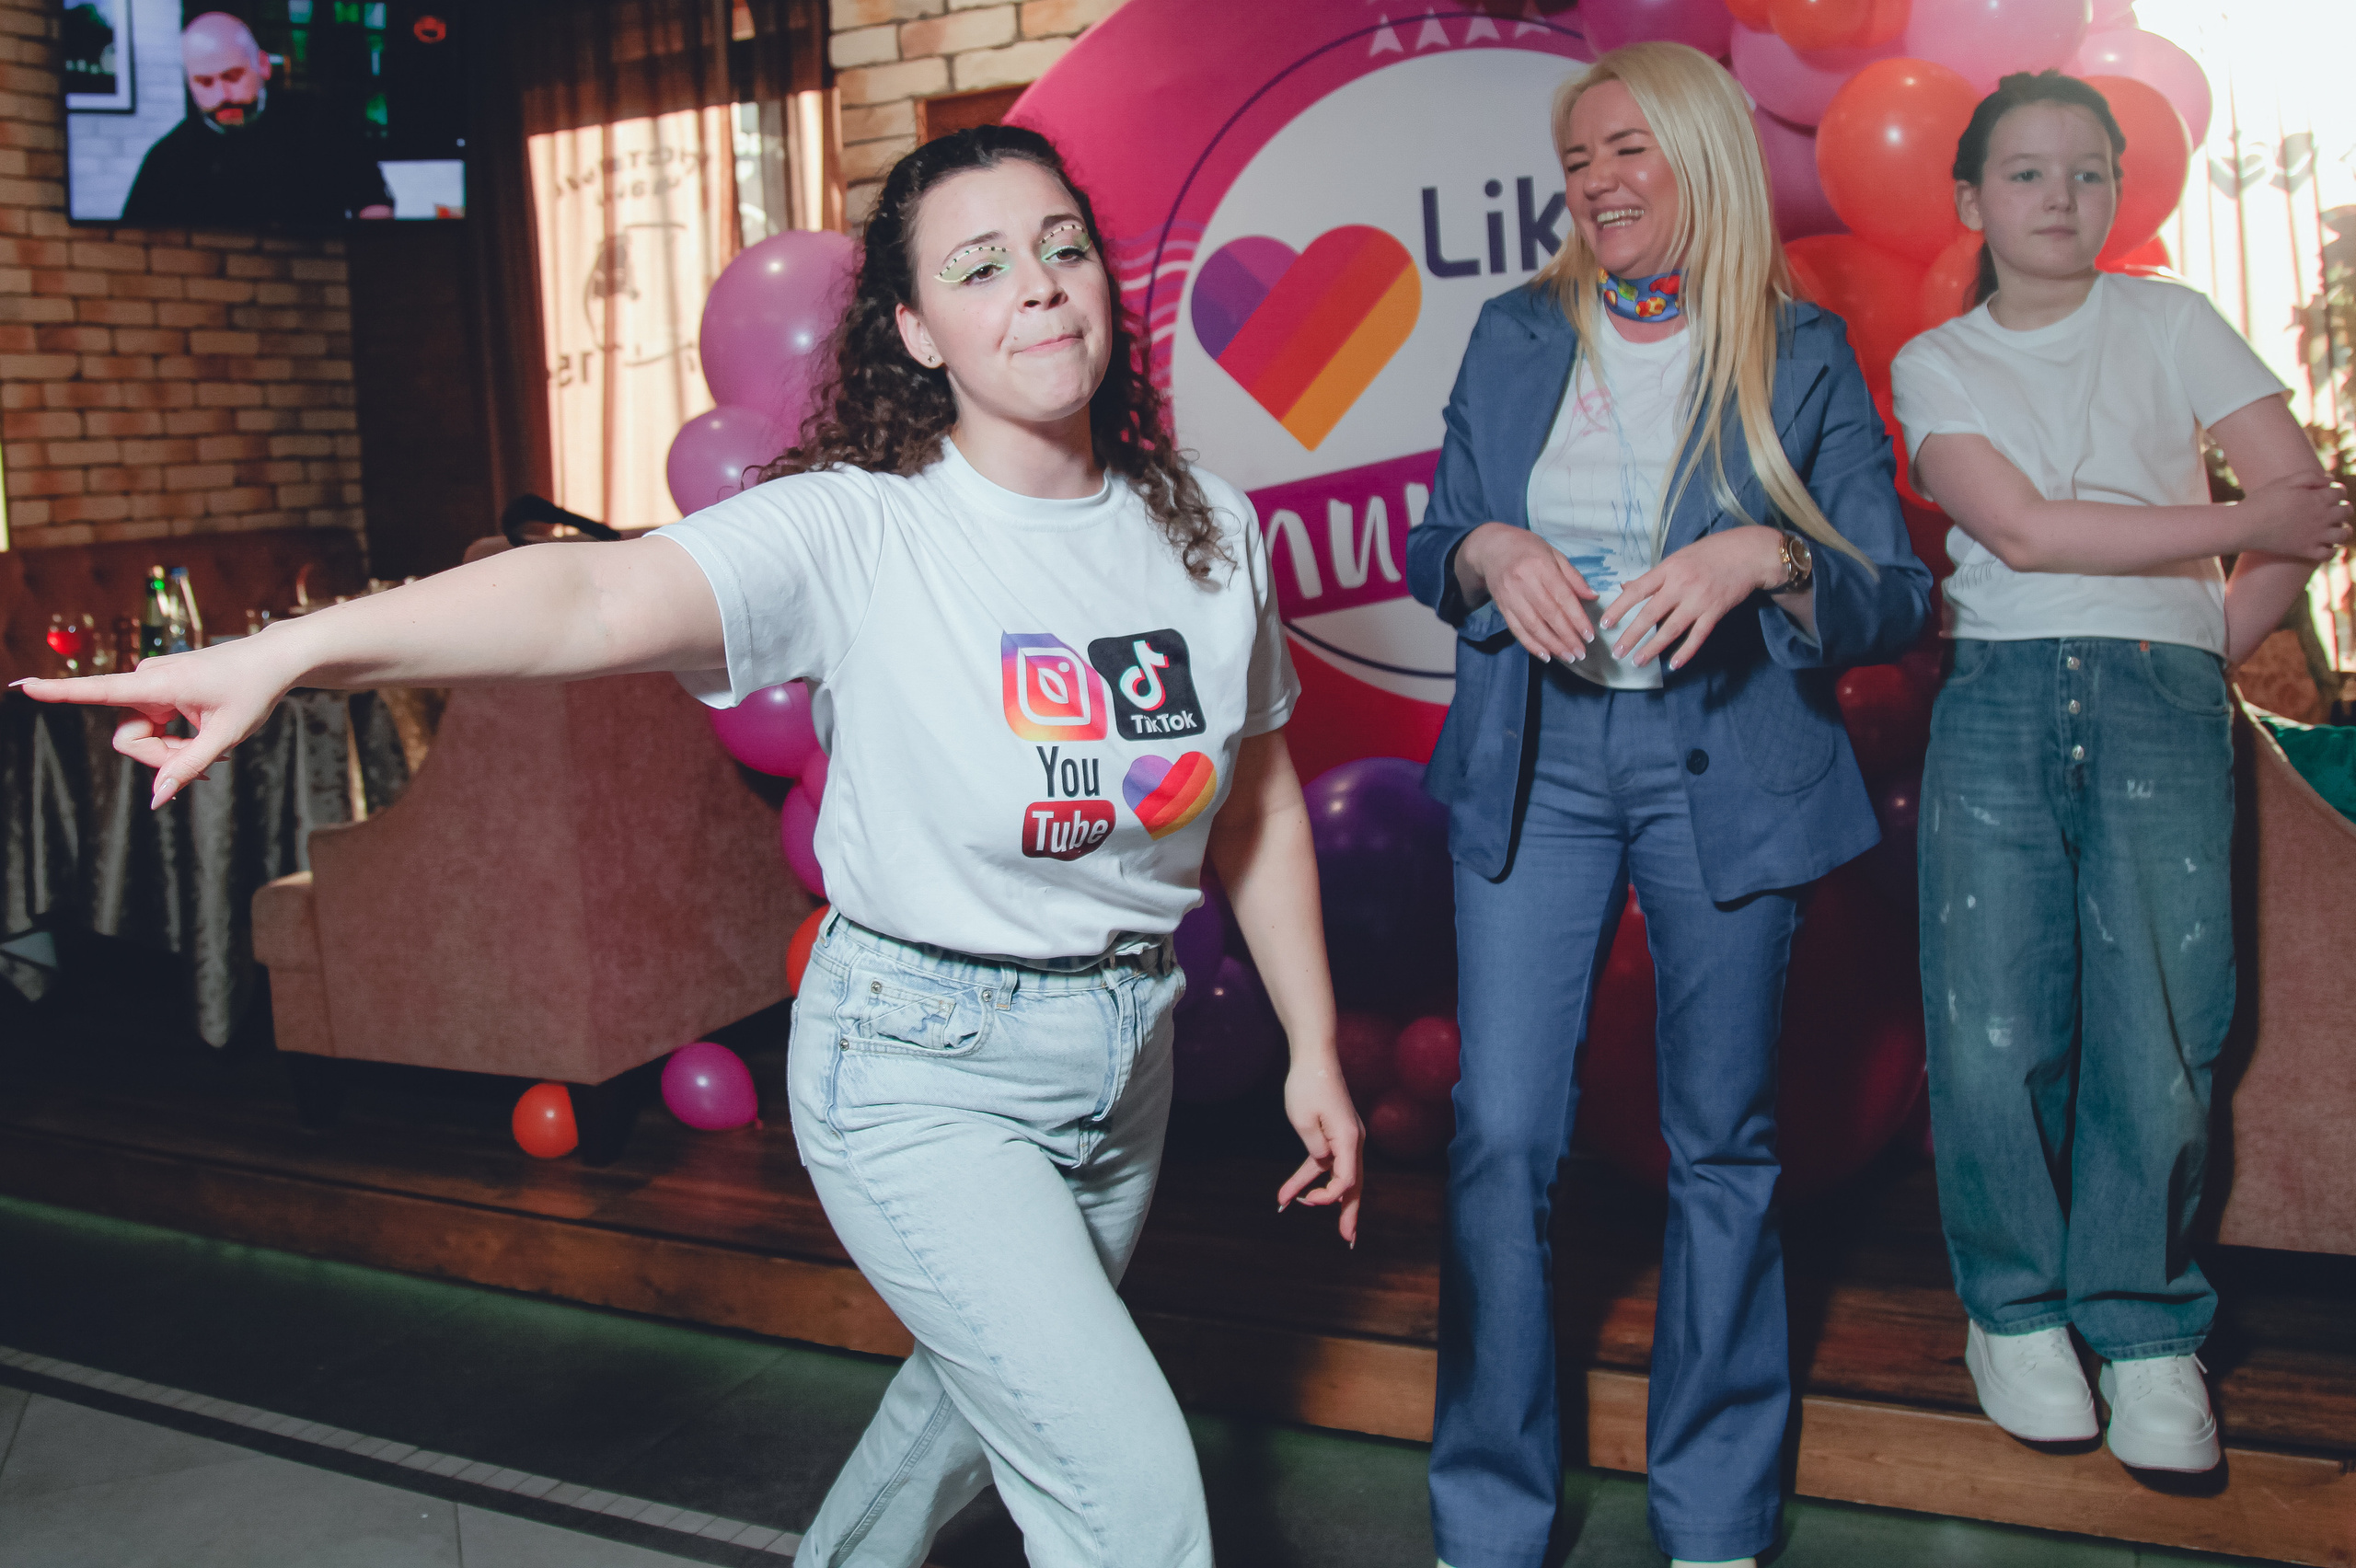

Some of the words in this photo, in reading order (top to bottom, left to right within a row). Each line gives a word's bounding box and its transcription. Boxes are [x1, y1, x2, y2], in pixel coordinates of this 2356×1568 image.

[1130, 709, 1198, 734] TikTok
[1036, 745, 1101, 798] You
[1032, 810, 1109, 854] Tube
